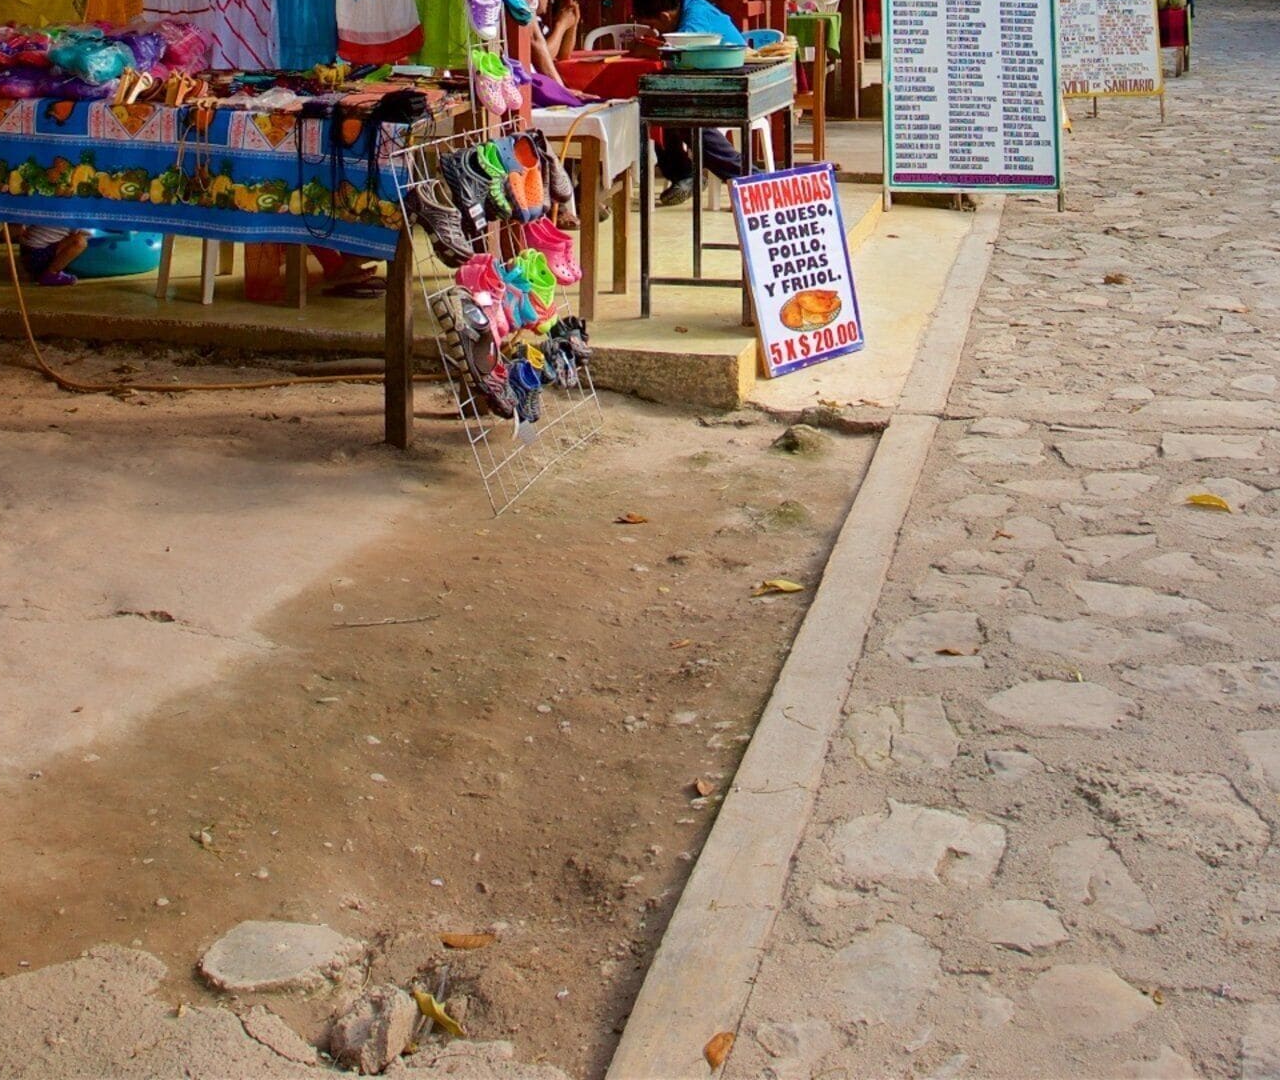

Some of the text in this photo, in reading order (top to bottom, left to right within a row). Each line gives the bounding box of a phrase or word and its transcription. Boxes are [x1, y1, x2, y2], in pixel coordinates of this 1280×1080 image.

[1104, 79, 1154, 93] SANITARIO
[740, 172, 831, 215] EMPANADAS
[747, 203, 832, 231] DE QUESO,
[763, 221, 825, 245] CARNE,
[768, 238, 826, 262] POLLO,
[772, 253, 828, 278] PAPAS
[764, 269, 841, 297] Y FRIJOL.
[770, 342, 783, 365] 5
